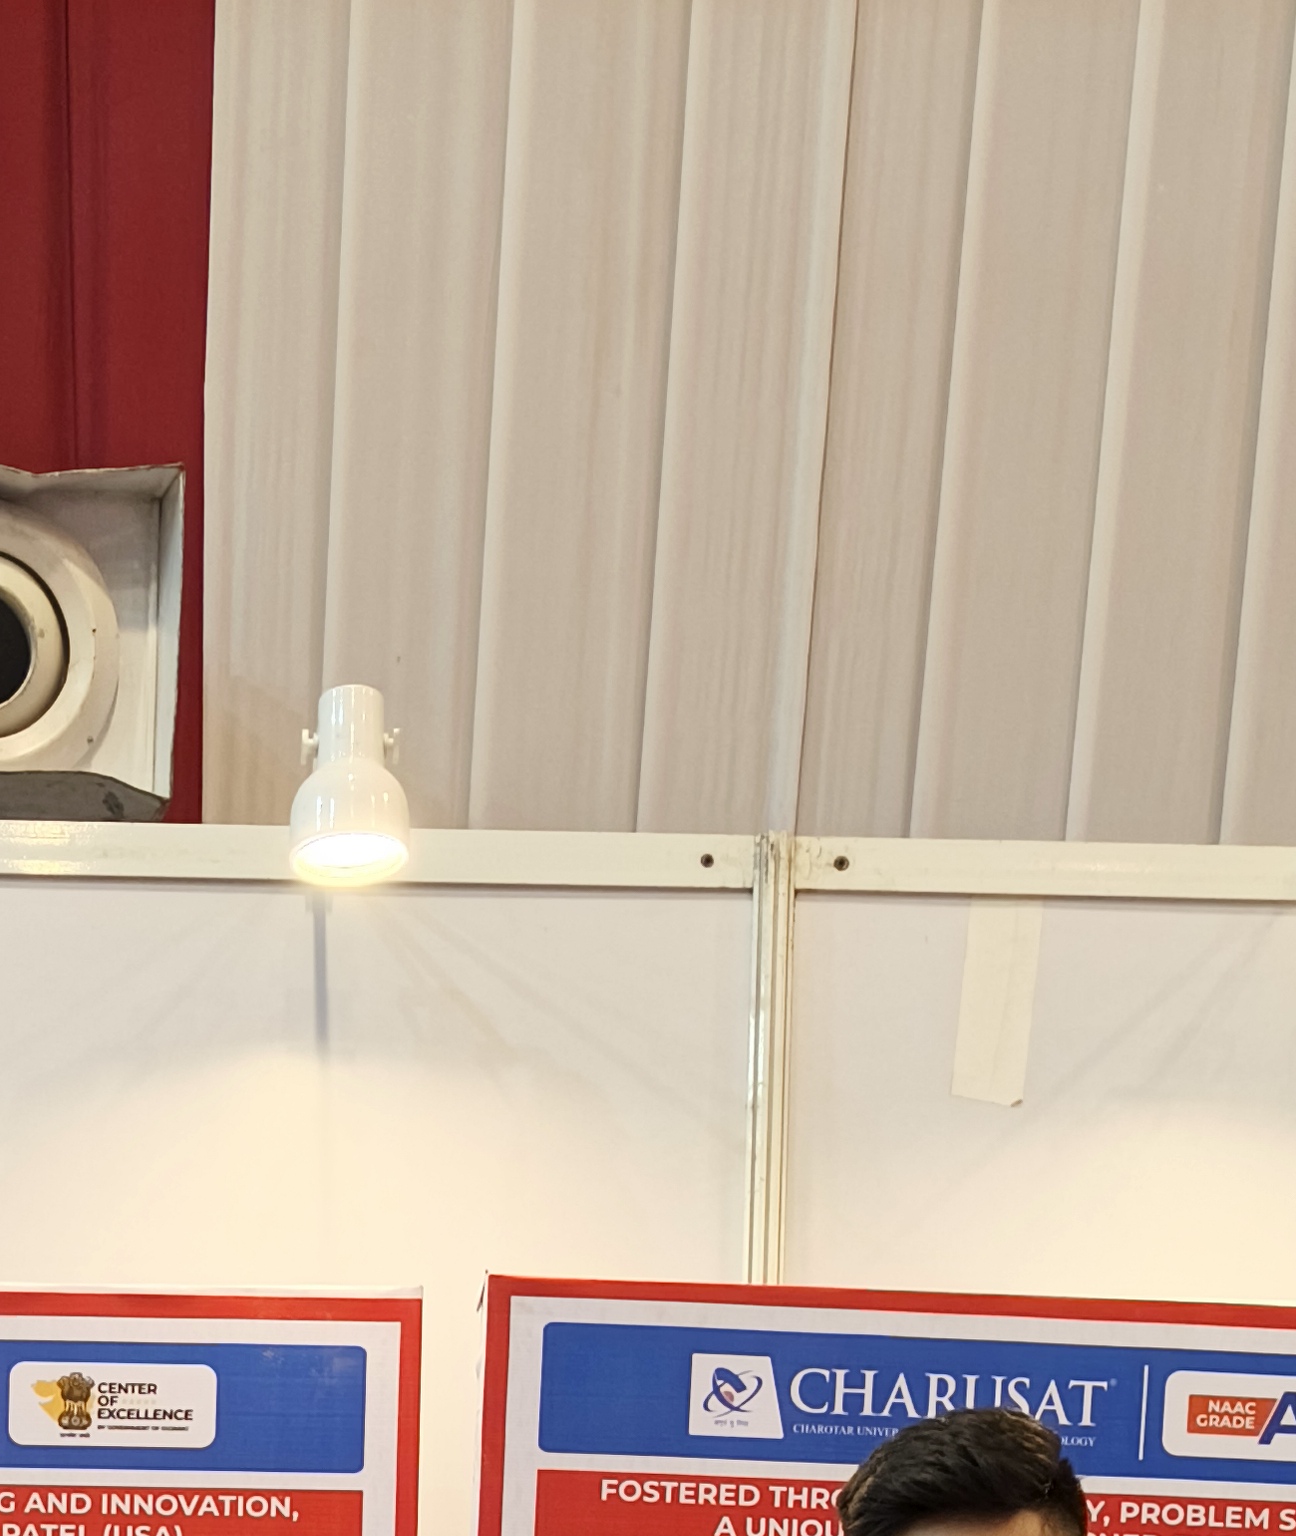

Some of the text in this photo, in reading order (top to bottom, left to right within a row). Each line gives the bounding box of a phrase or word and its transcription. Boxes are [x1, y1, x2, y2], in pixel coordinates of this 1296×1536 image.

[97, 1382, 158, 1394] CENTER
[97, 1395, 118, 1406] OF
[1208, 1400, 1256, 1415] NAAC
[97, 1408, 194, 1421] EXCELLENCE
[1195, 1414, 1255, 1429] GRADE
[792, 1423, 855, 1436] CHAROTAR
[600, 1479, 761, 1507] FOSTERED
[24, 1493, 92, 1515] AND
[102, 1494, 300, 1523] INNOVATION,
[1120, 1501, 1270, 1530] PROBLEM
